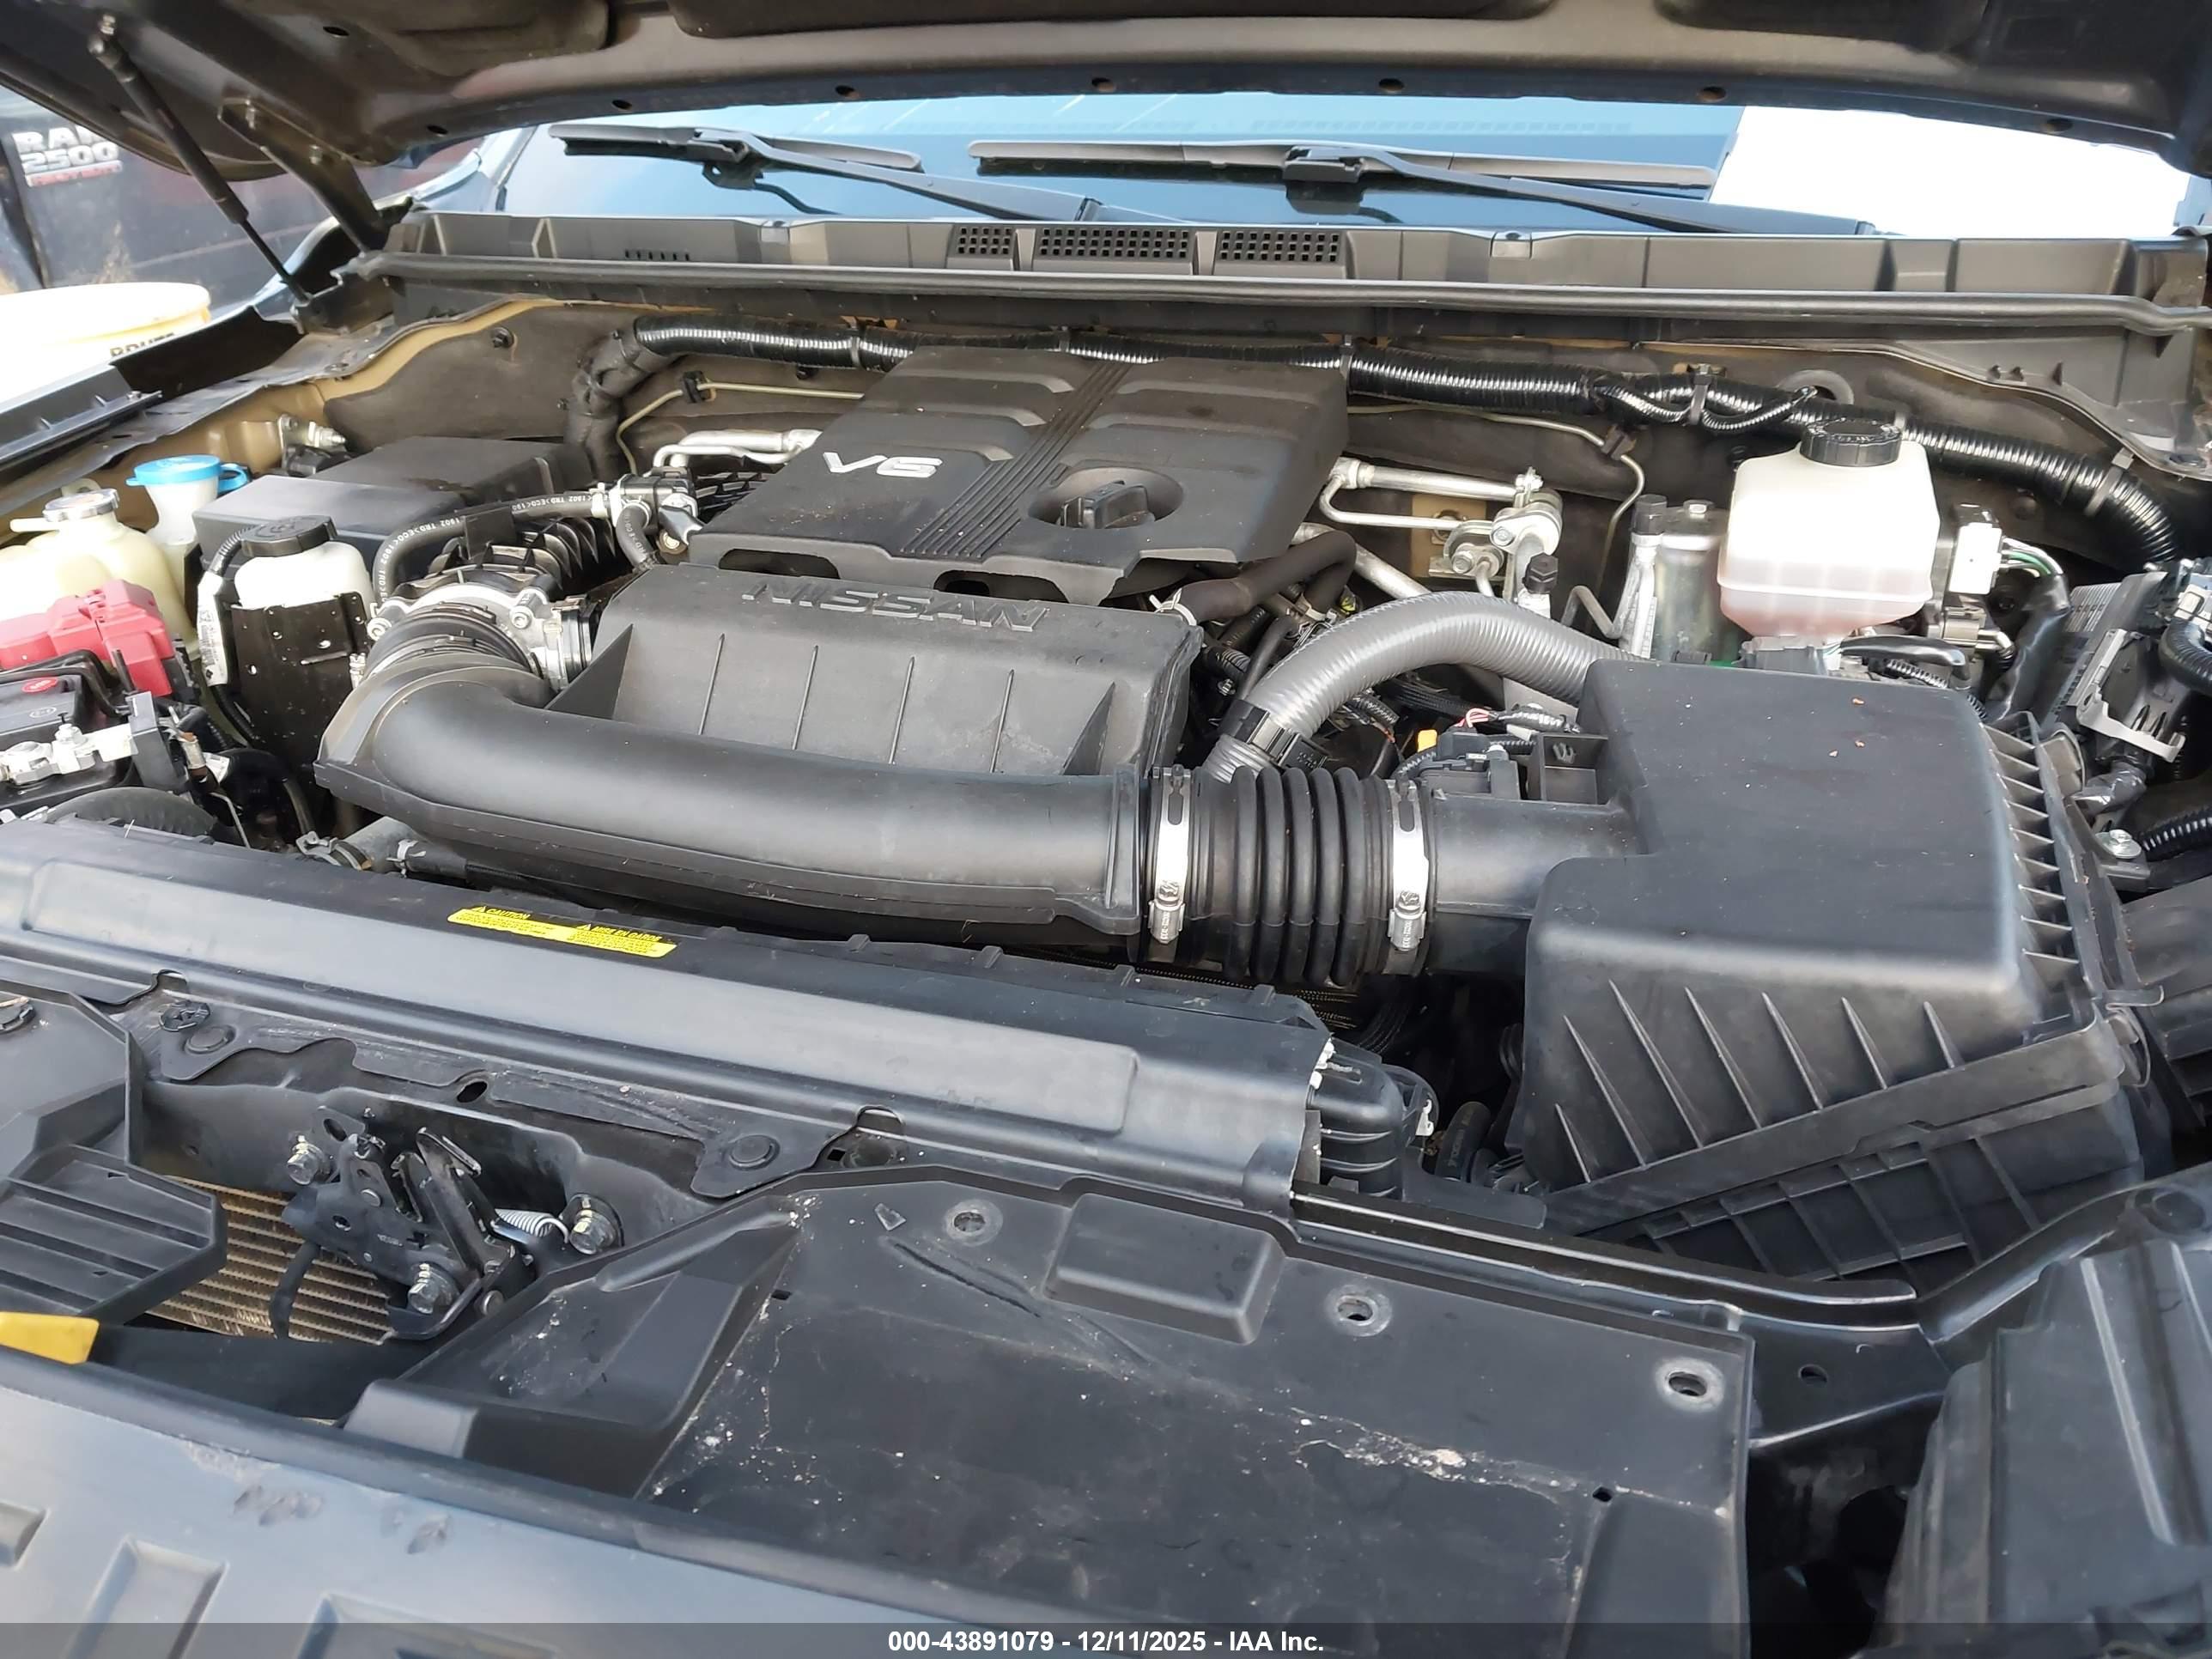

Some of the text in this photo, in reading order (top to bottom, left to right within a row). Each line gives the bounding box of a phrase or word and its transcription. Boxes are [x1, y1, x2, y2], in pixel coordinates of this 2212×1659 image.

[21, 142, 118, 174] 2500
[823, 452, 943, 478] V6
[741, 582, 1051, 632] NISSAN
[486, 908, 531, 920] CAUTION
